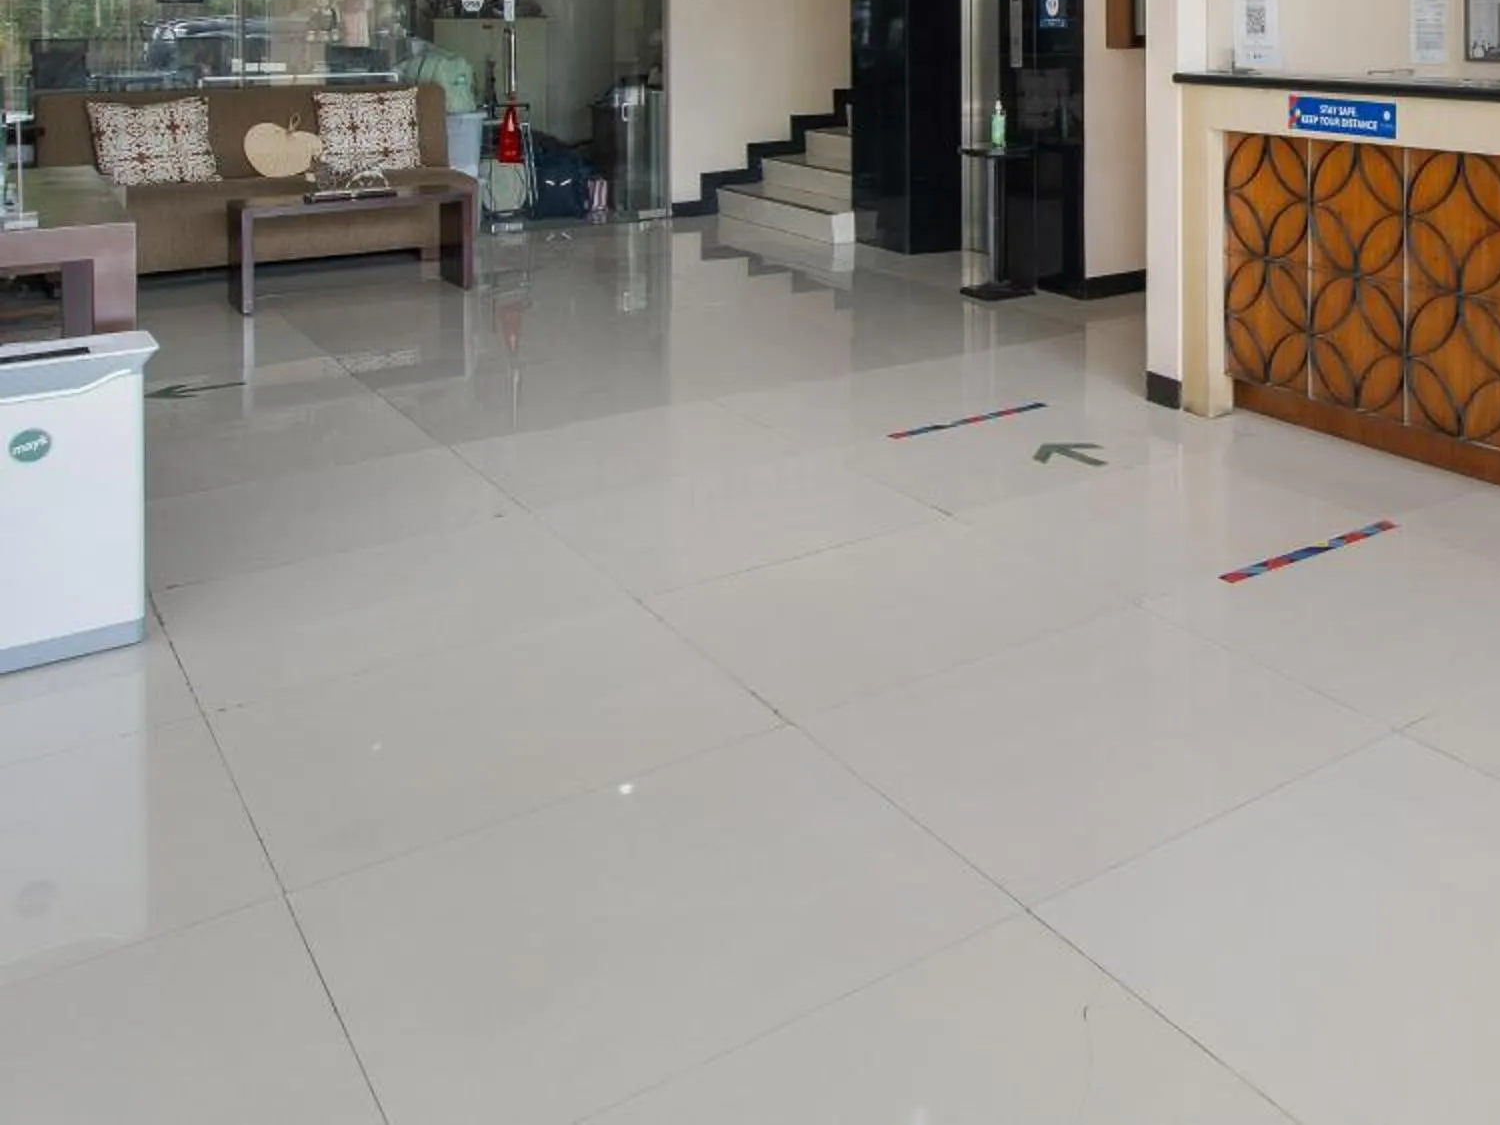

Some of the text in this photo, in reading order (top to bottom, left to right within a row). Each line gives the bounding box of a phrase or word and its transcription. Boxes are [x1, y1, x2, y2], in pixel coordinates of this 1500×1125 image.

[1319, 104, 1338, 115] STAY
[1301, 115, 1378, 131] KEEP YOUR DISTANCE
